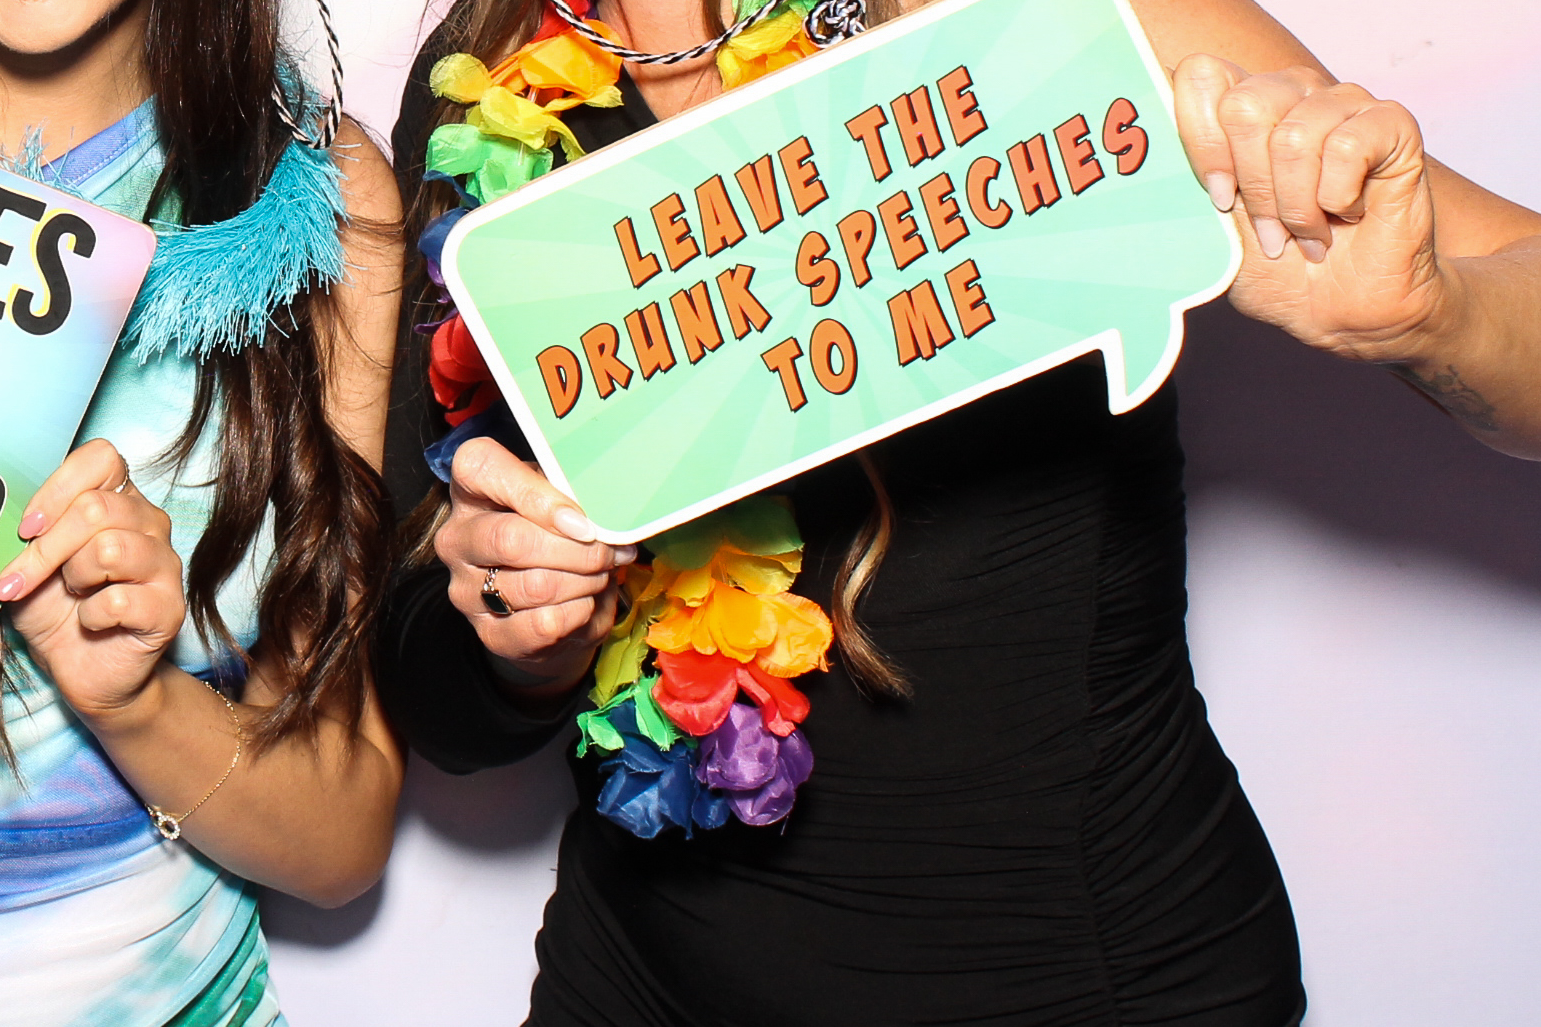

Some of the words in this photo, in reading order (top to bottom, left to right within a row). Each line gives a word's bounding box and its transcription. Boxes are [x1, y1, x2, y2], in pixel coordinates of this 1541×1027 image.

[536, 264, 772, 419] DRUNK
[795, 97, 1149, 307] SPEECHES
[613, 136, 828, 289] LEAVE
[846, 65, 988, 182] THE
[761, 319, 859, 412] TO
[887, 259, 996, 367] ME
